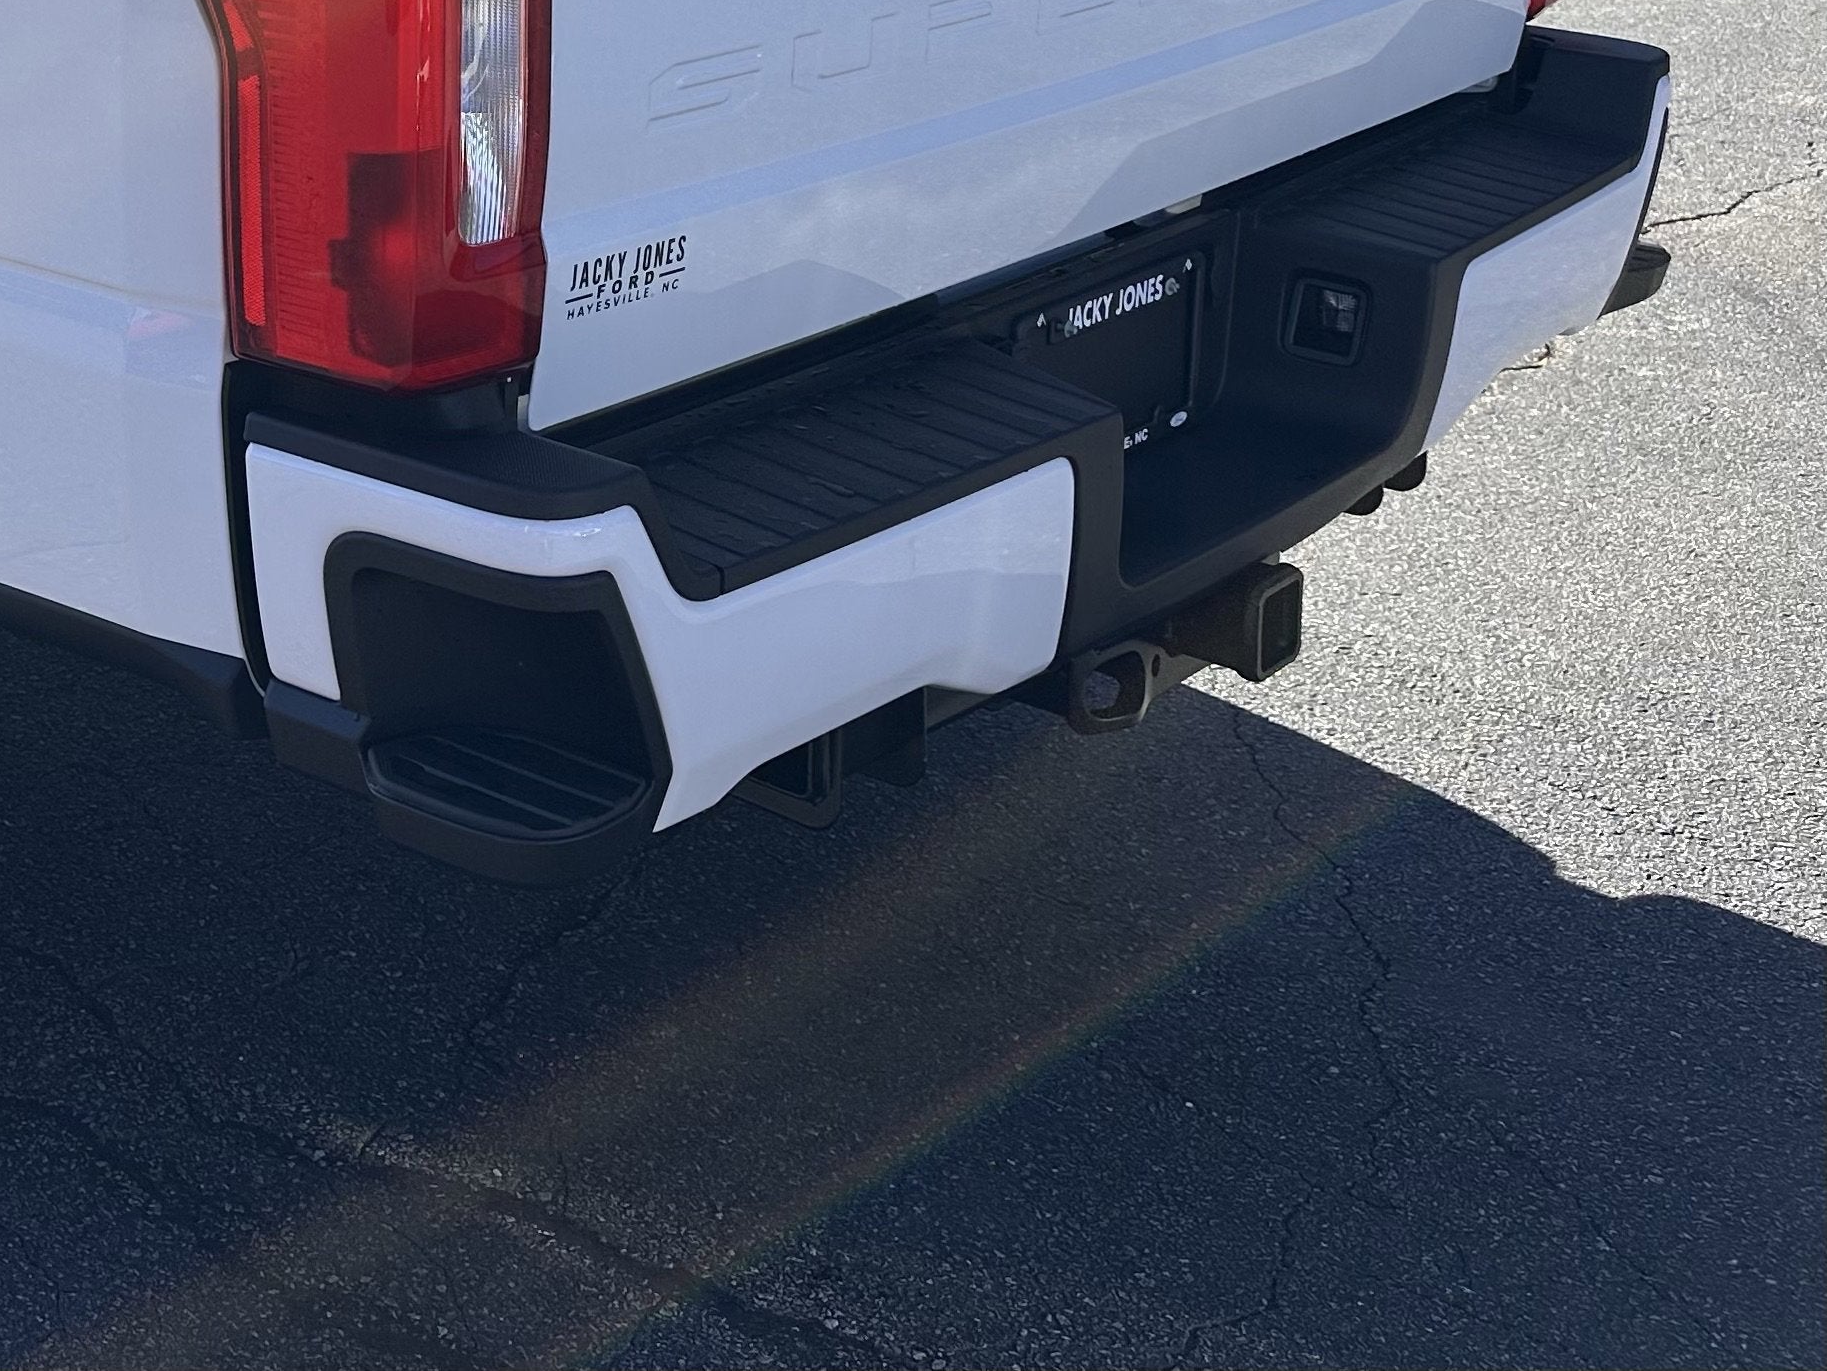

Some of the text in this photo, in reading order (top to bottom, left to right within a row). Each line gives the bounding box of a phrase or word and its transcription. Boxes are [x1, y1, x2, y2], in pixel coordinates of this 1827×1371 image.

[570, 234, 687, 292] JACKY JONES
[596, 270, 655, 299] FORD
[661, 278, 680, 293] NC
[1068, 274, 1164, 330] JACKY JONES
